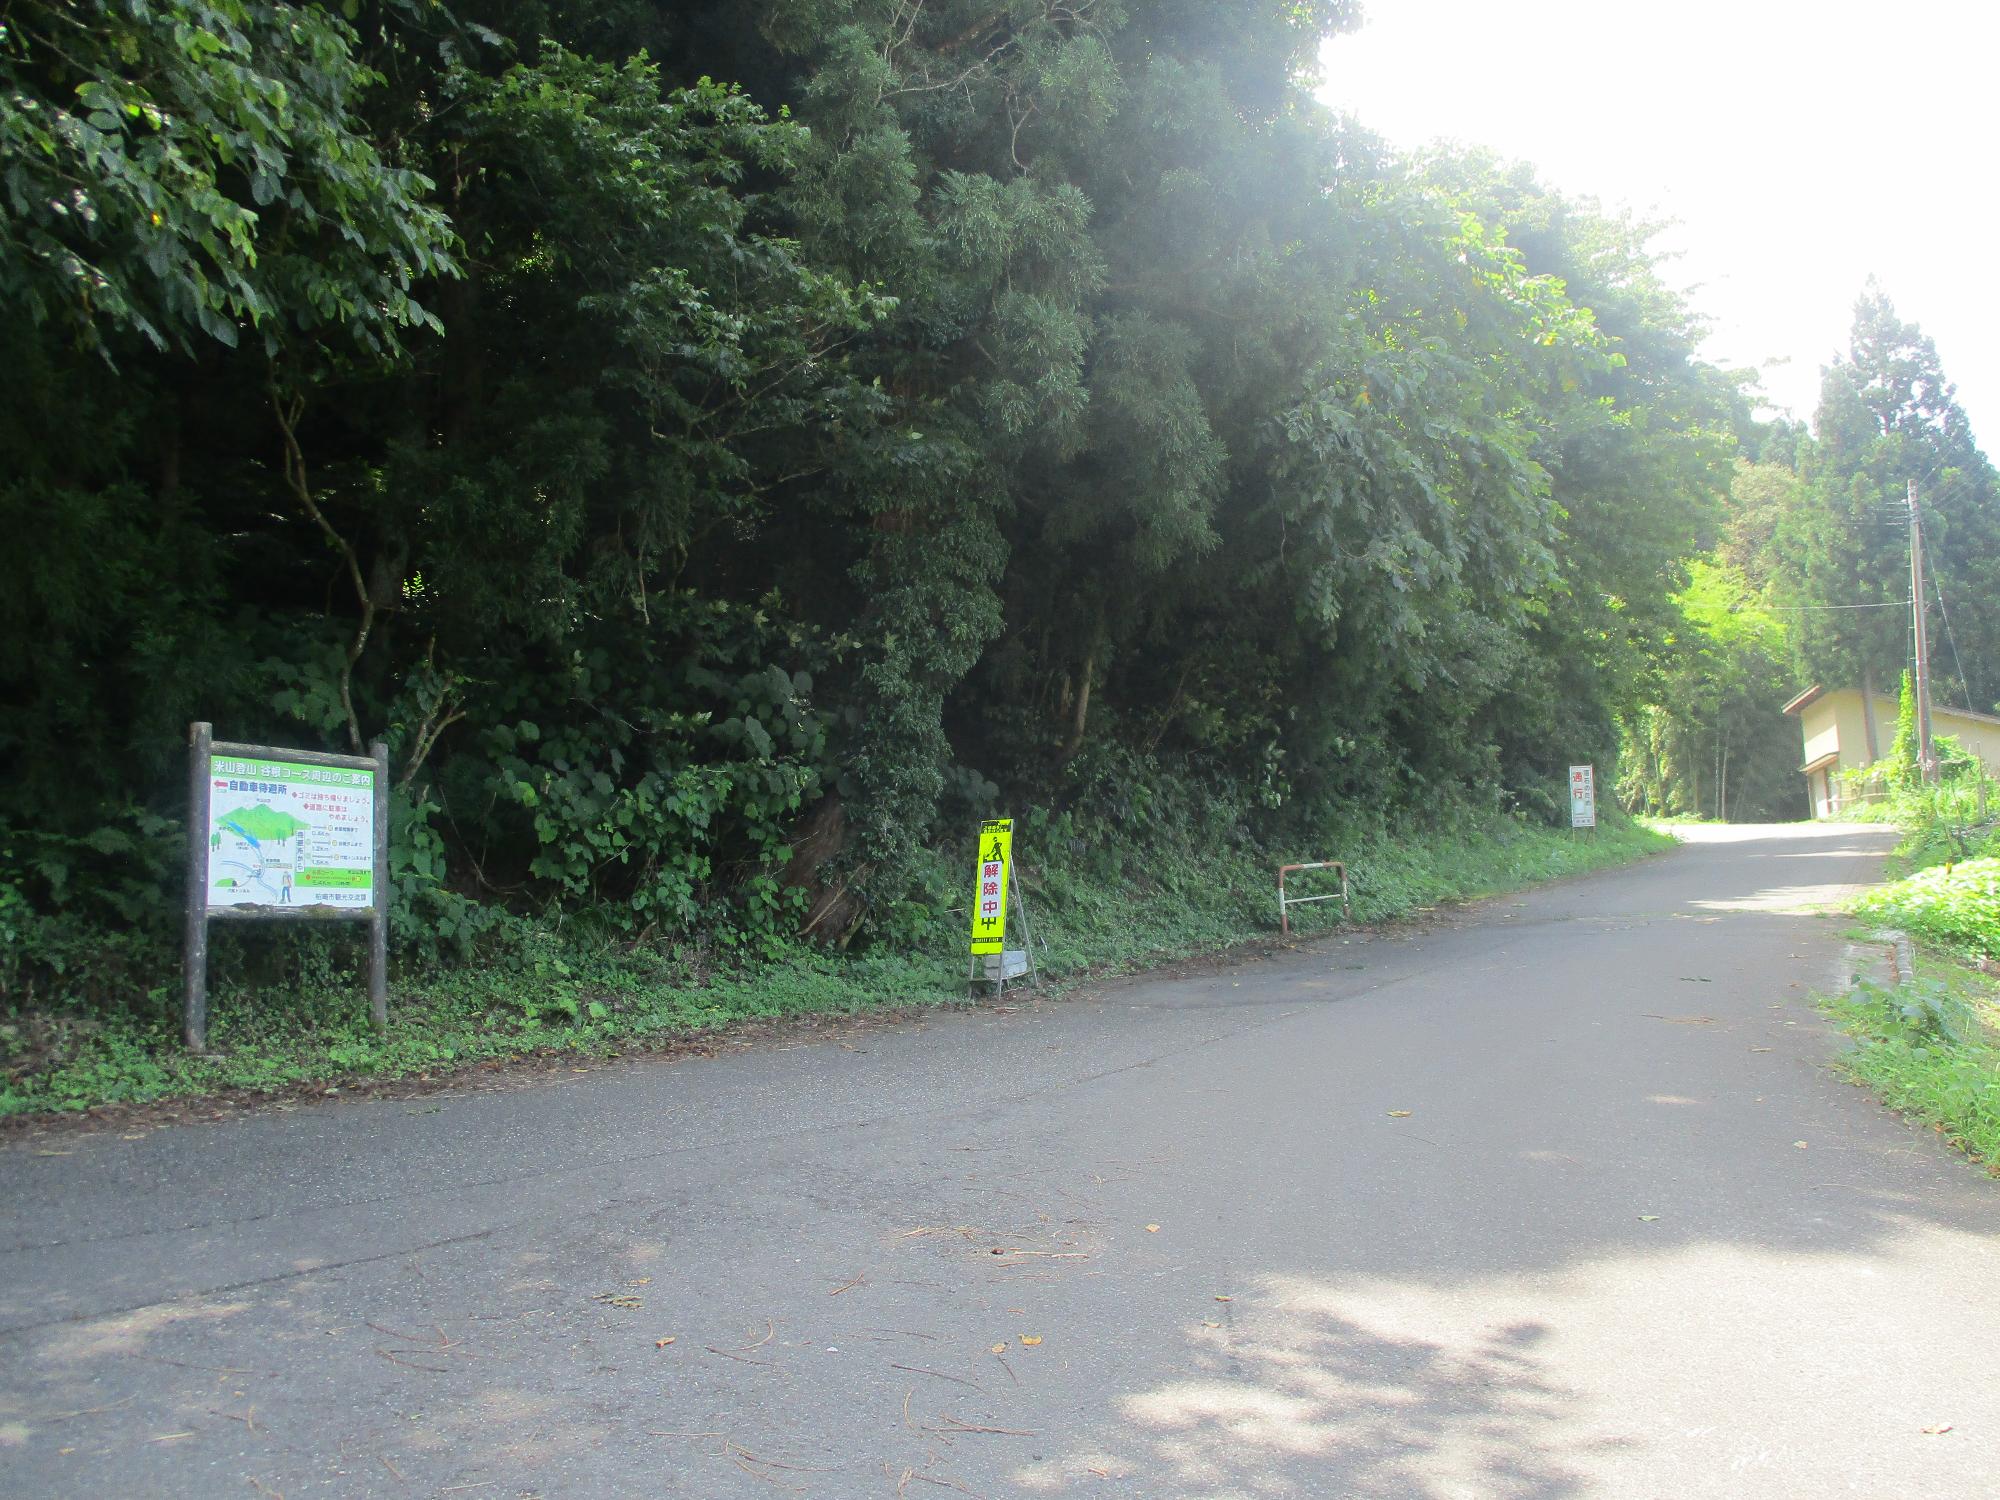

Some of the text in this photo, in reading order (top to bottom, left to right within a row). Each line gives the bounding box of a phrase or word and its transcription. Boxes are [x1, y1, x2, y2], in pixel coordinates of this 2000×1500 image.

[214, 760, 257, 775] 米山登山
[982, 863, 999, 914] 解除中
